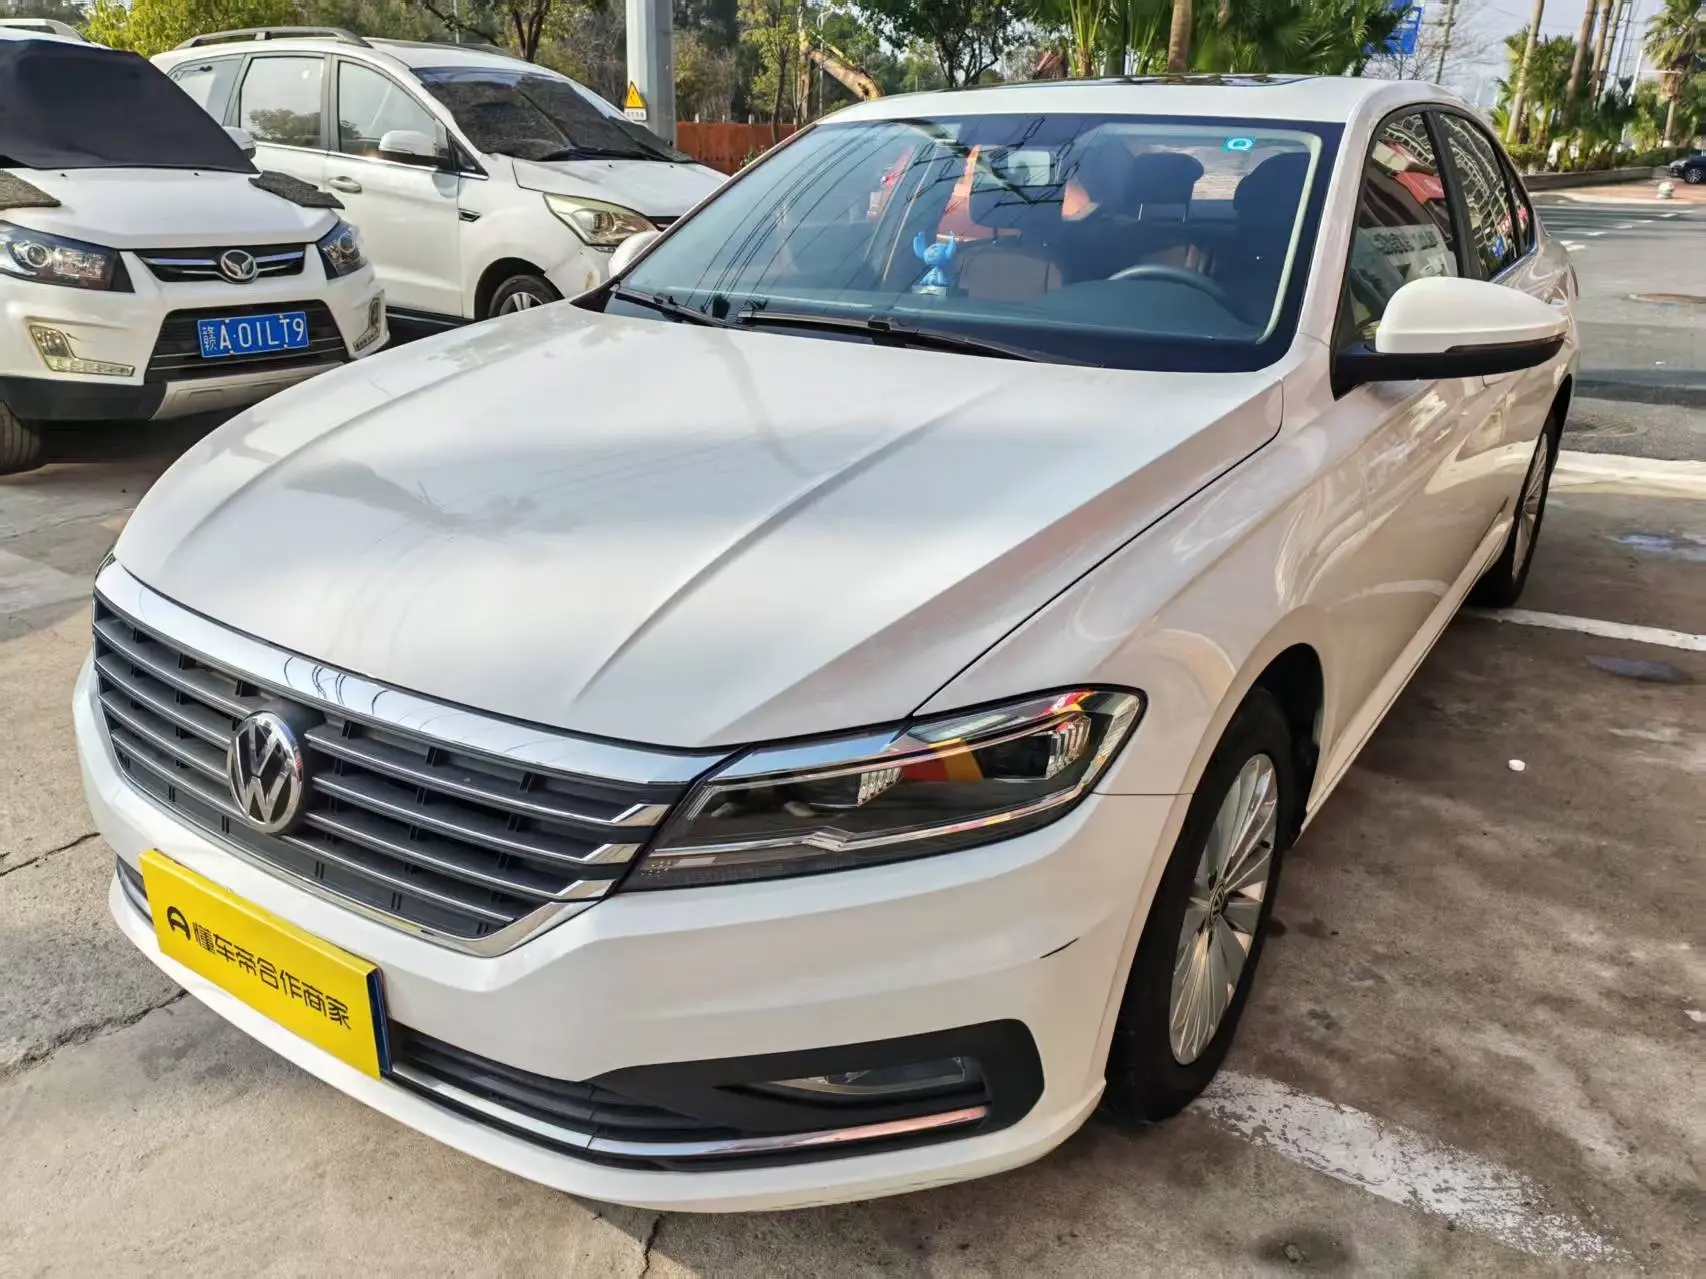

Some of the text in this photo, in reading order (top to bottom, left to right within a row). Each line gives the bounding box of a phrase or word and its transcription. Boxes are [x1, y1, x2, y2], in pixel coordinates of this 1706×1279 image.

[193, 921, 351, 1030] 懂车帝合作商家
